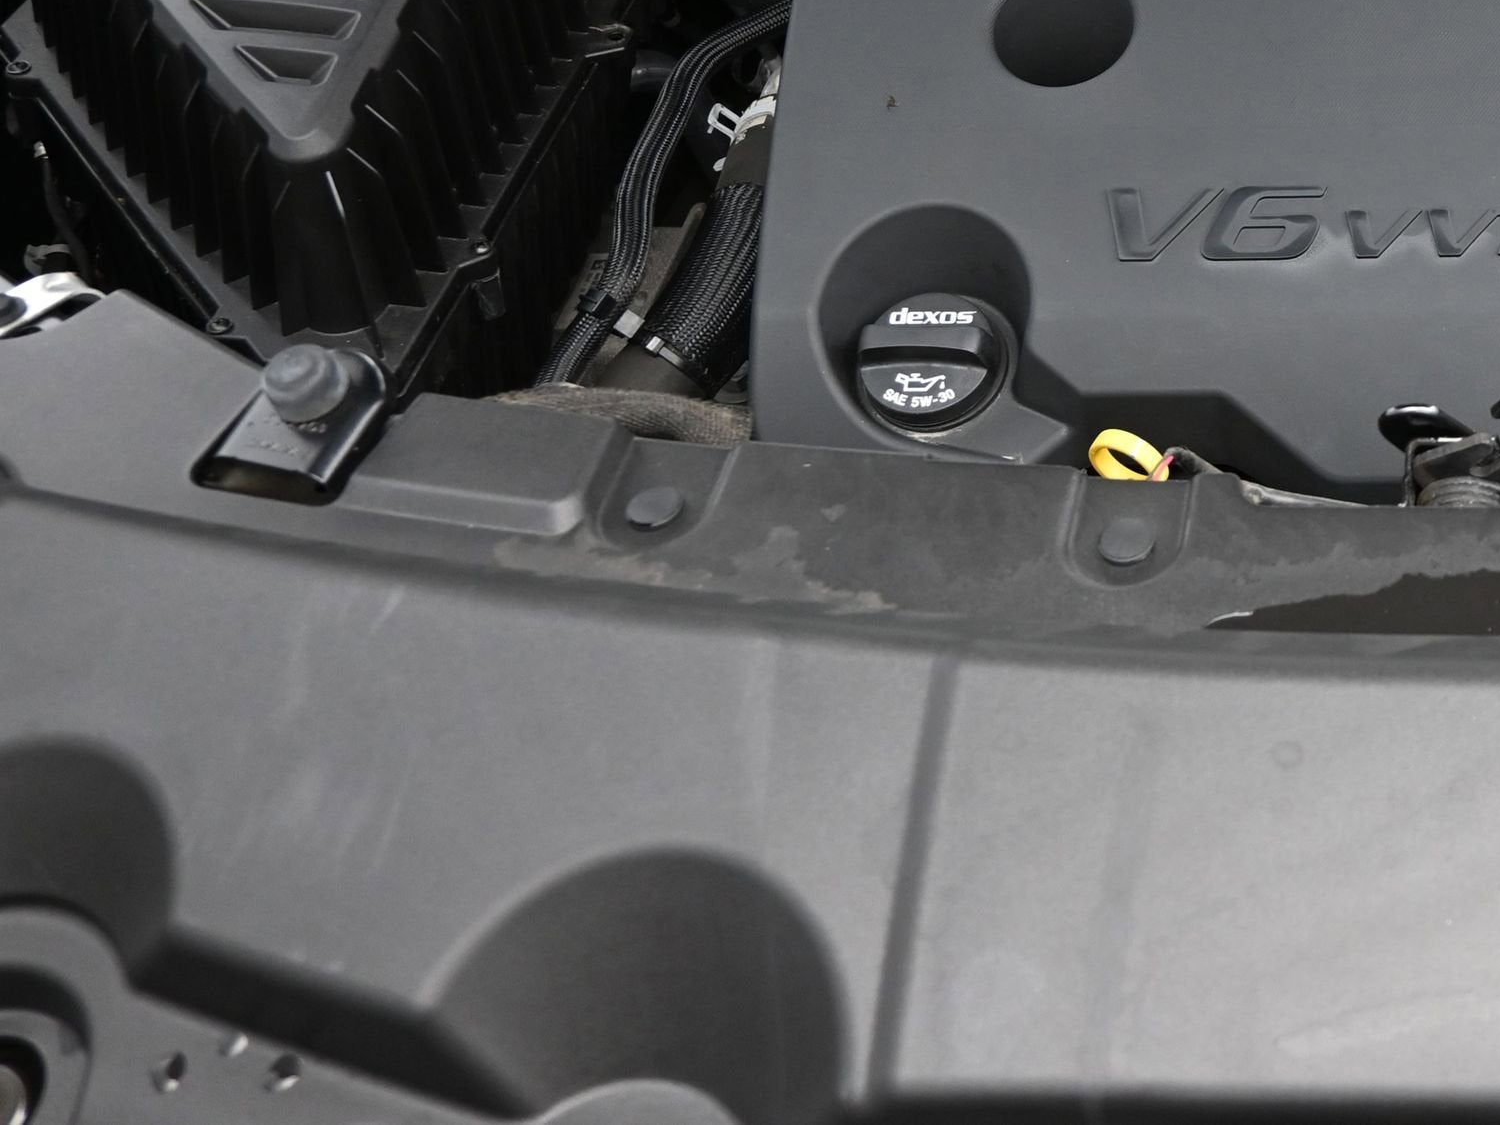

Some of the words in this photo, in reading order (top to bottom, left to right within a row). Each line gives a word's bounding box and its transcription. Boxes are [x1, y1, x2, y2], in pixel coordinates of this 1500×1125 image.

[1106, 185, 1327, 263] V6
[888, 307, 977, 325] dexos
[882, 388, 908, 406] SAE
[910, 388, 956, 408] 5W-30
